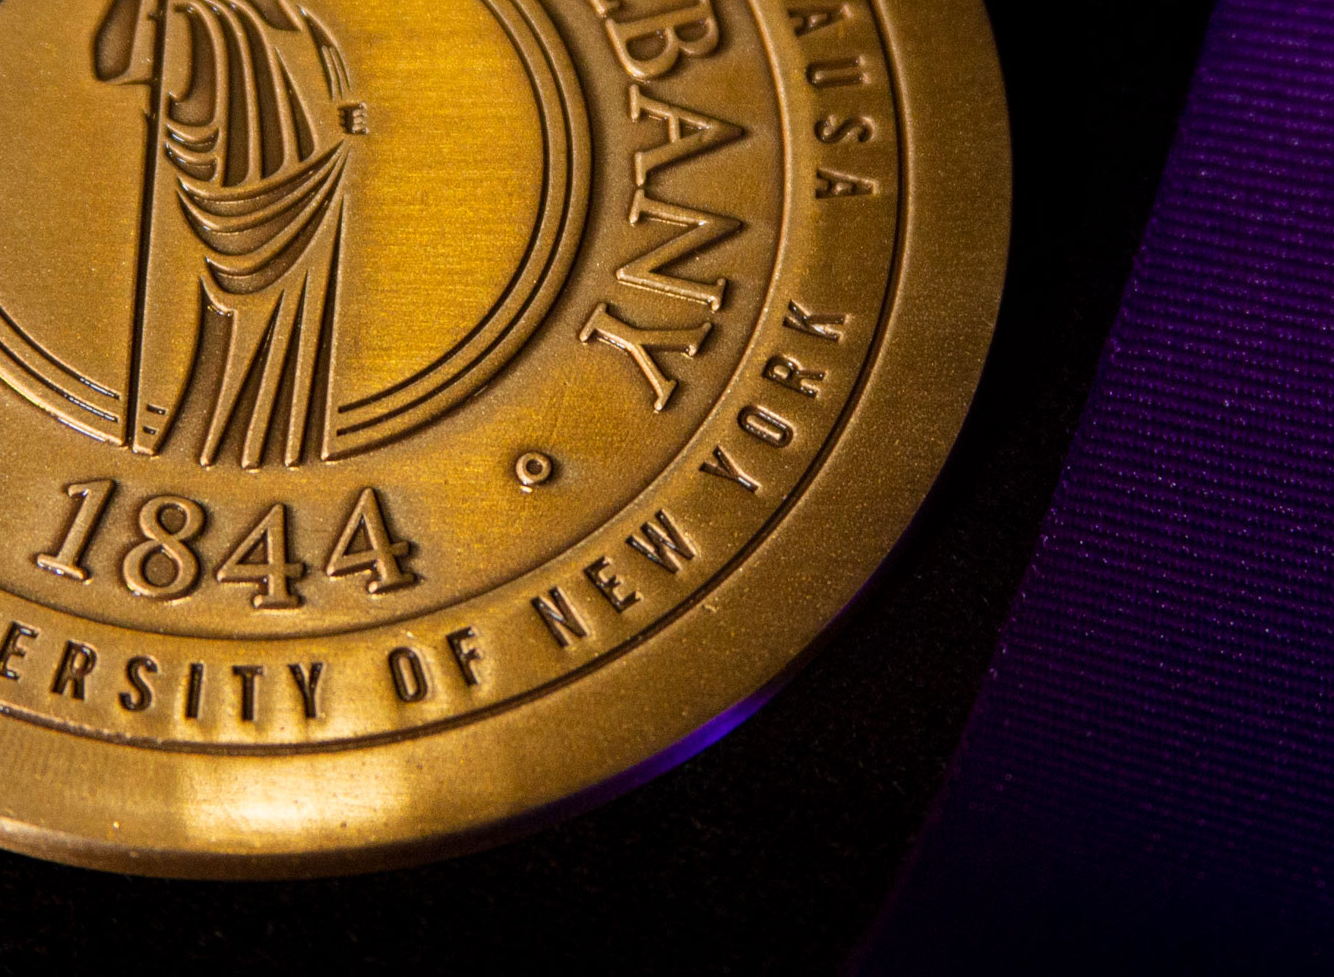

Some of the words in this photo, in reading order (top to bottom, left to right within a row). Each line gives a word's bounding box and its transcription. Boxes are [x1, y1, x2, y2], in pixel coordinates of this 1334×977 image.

[37, 478, 422, 610] 1844
[389, 626, 485, 703] OF
[532, 509, 699, 647] NEW
[699, 301, 853, 494] YORK
